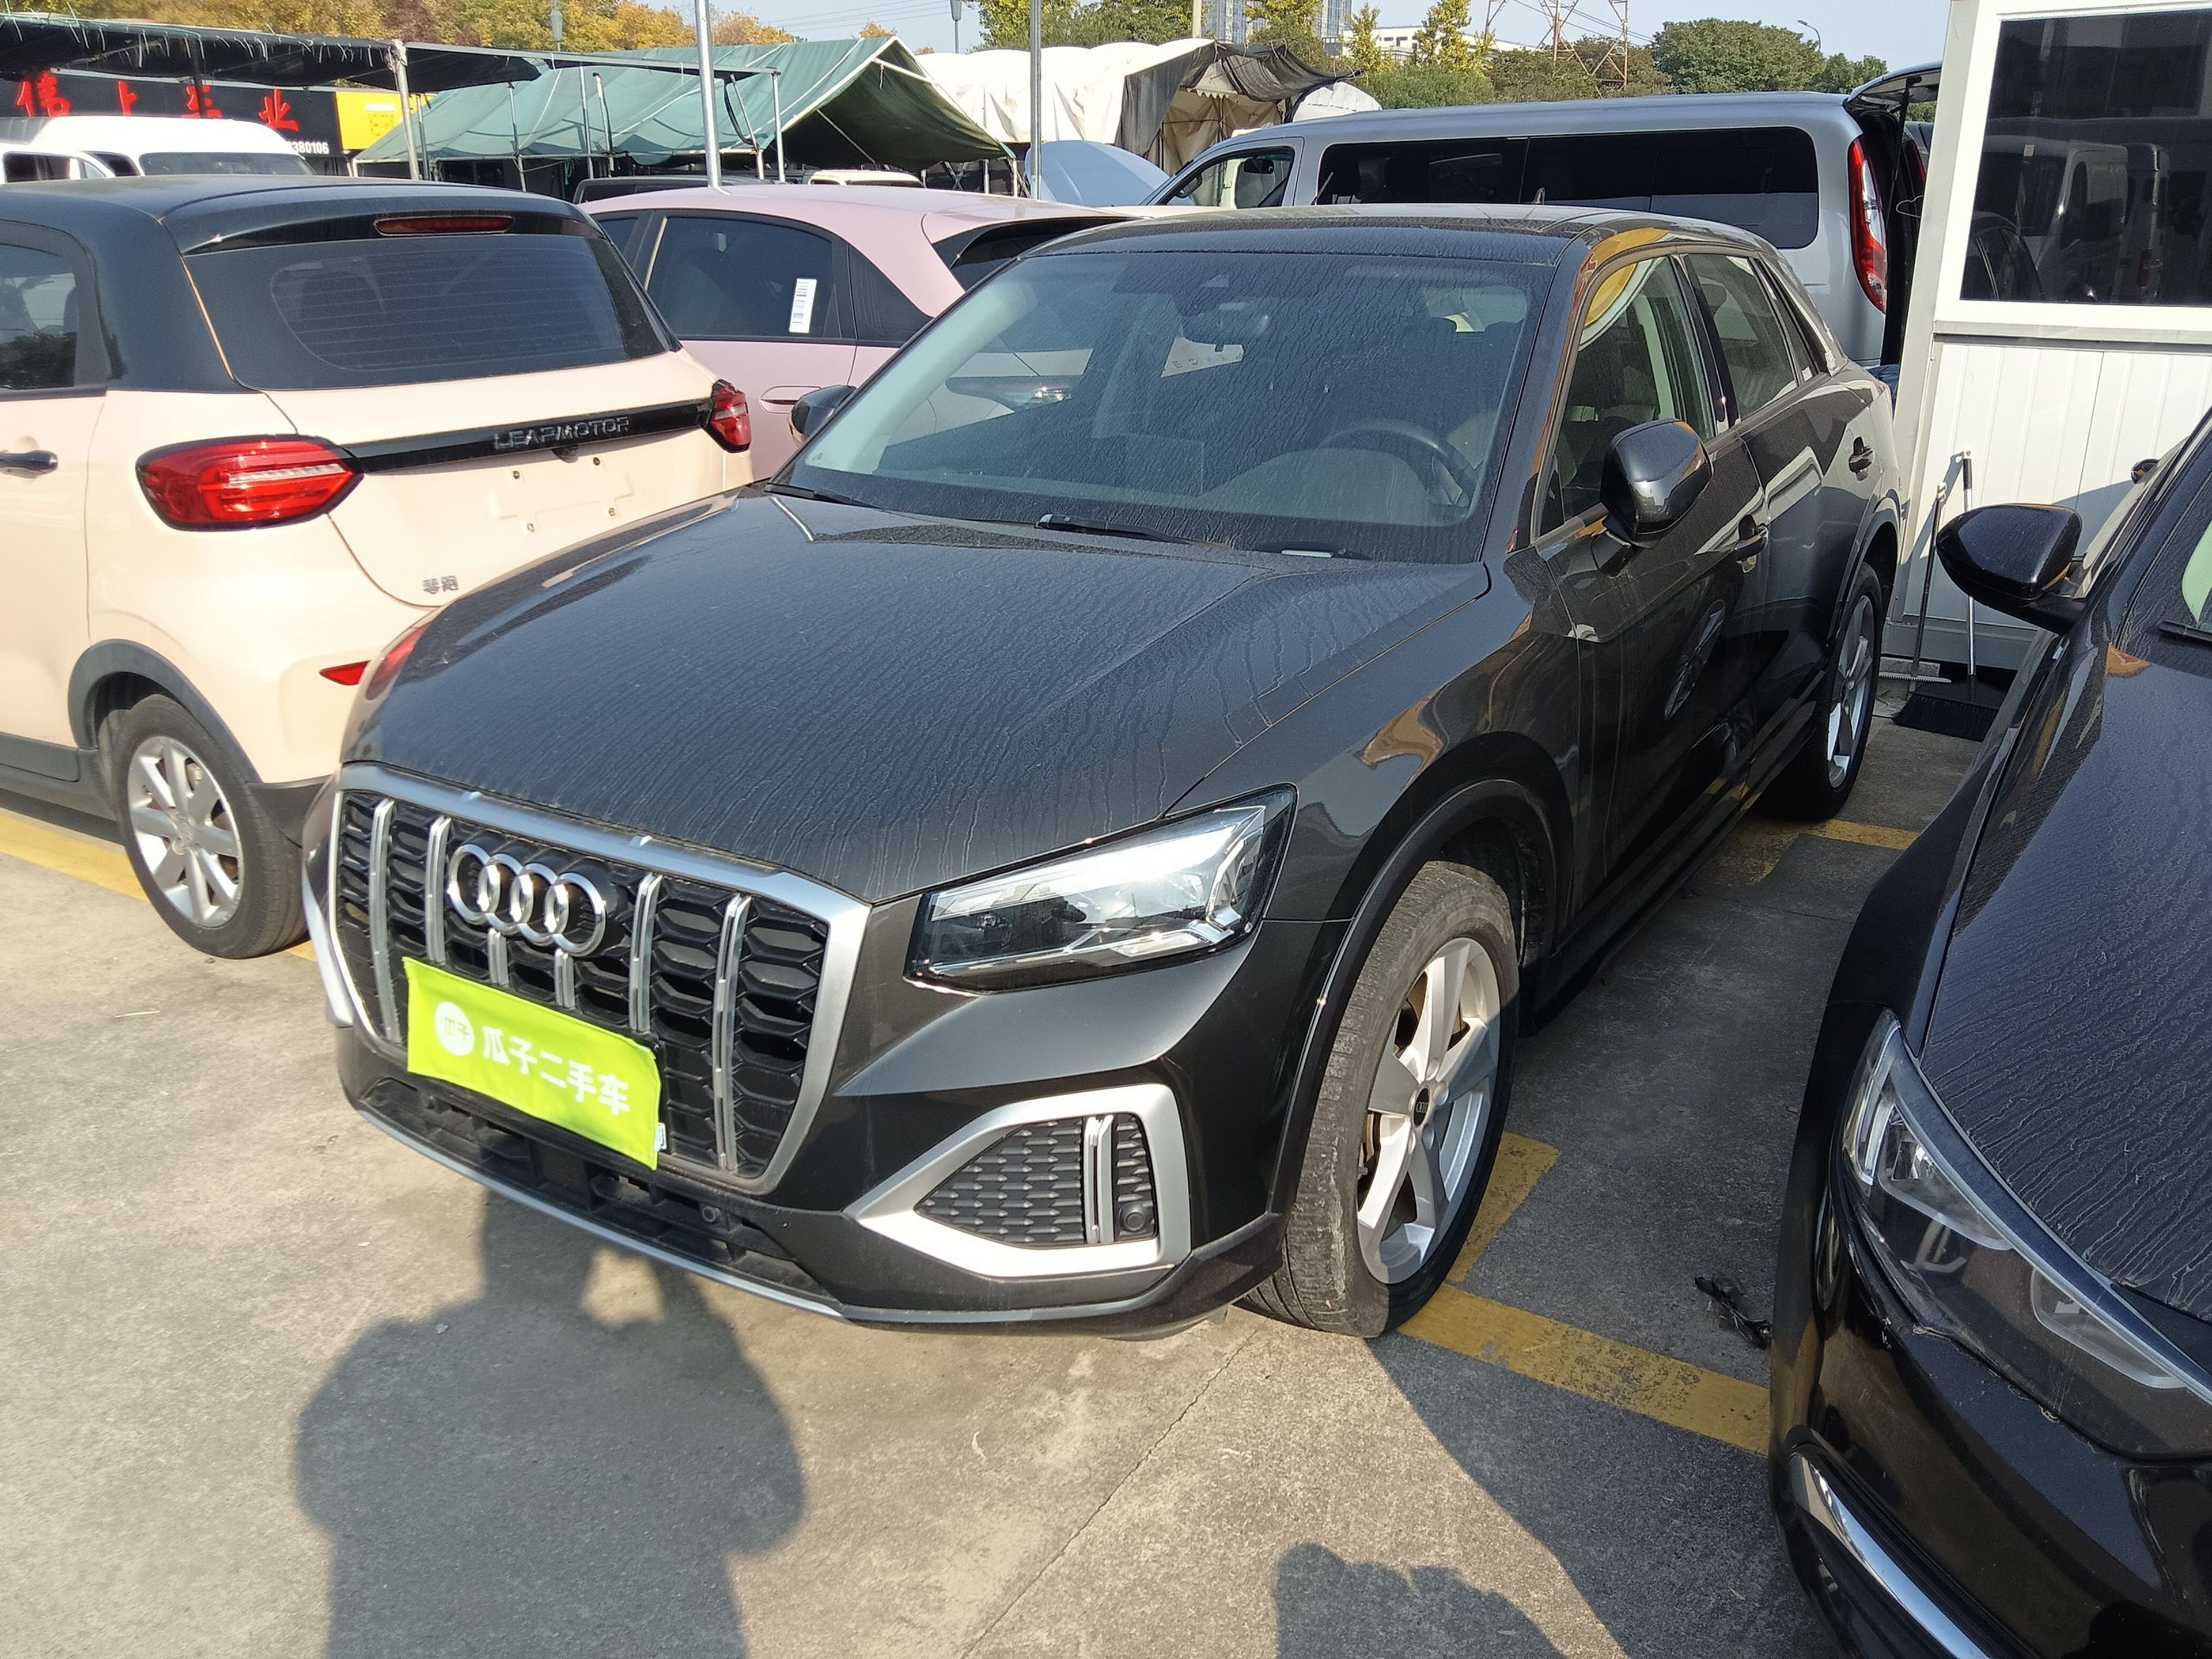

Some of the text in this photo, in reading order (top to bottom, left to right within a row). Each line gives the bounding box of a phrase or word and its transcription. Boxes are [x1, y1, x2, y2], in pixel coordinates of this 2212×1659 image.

[290, 141, 329, 154] 380106
[494, 416, 629, 450] LEAPMOTOR
[482, 1025, 631, 1116] 瓜子二手车
